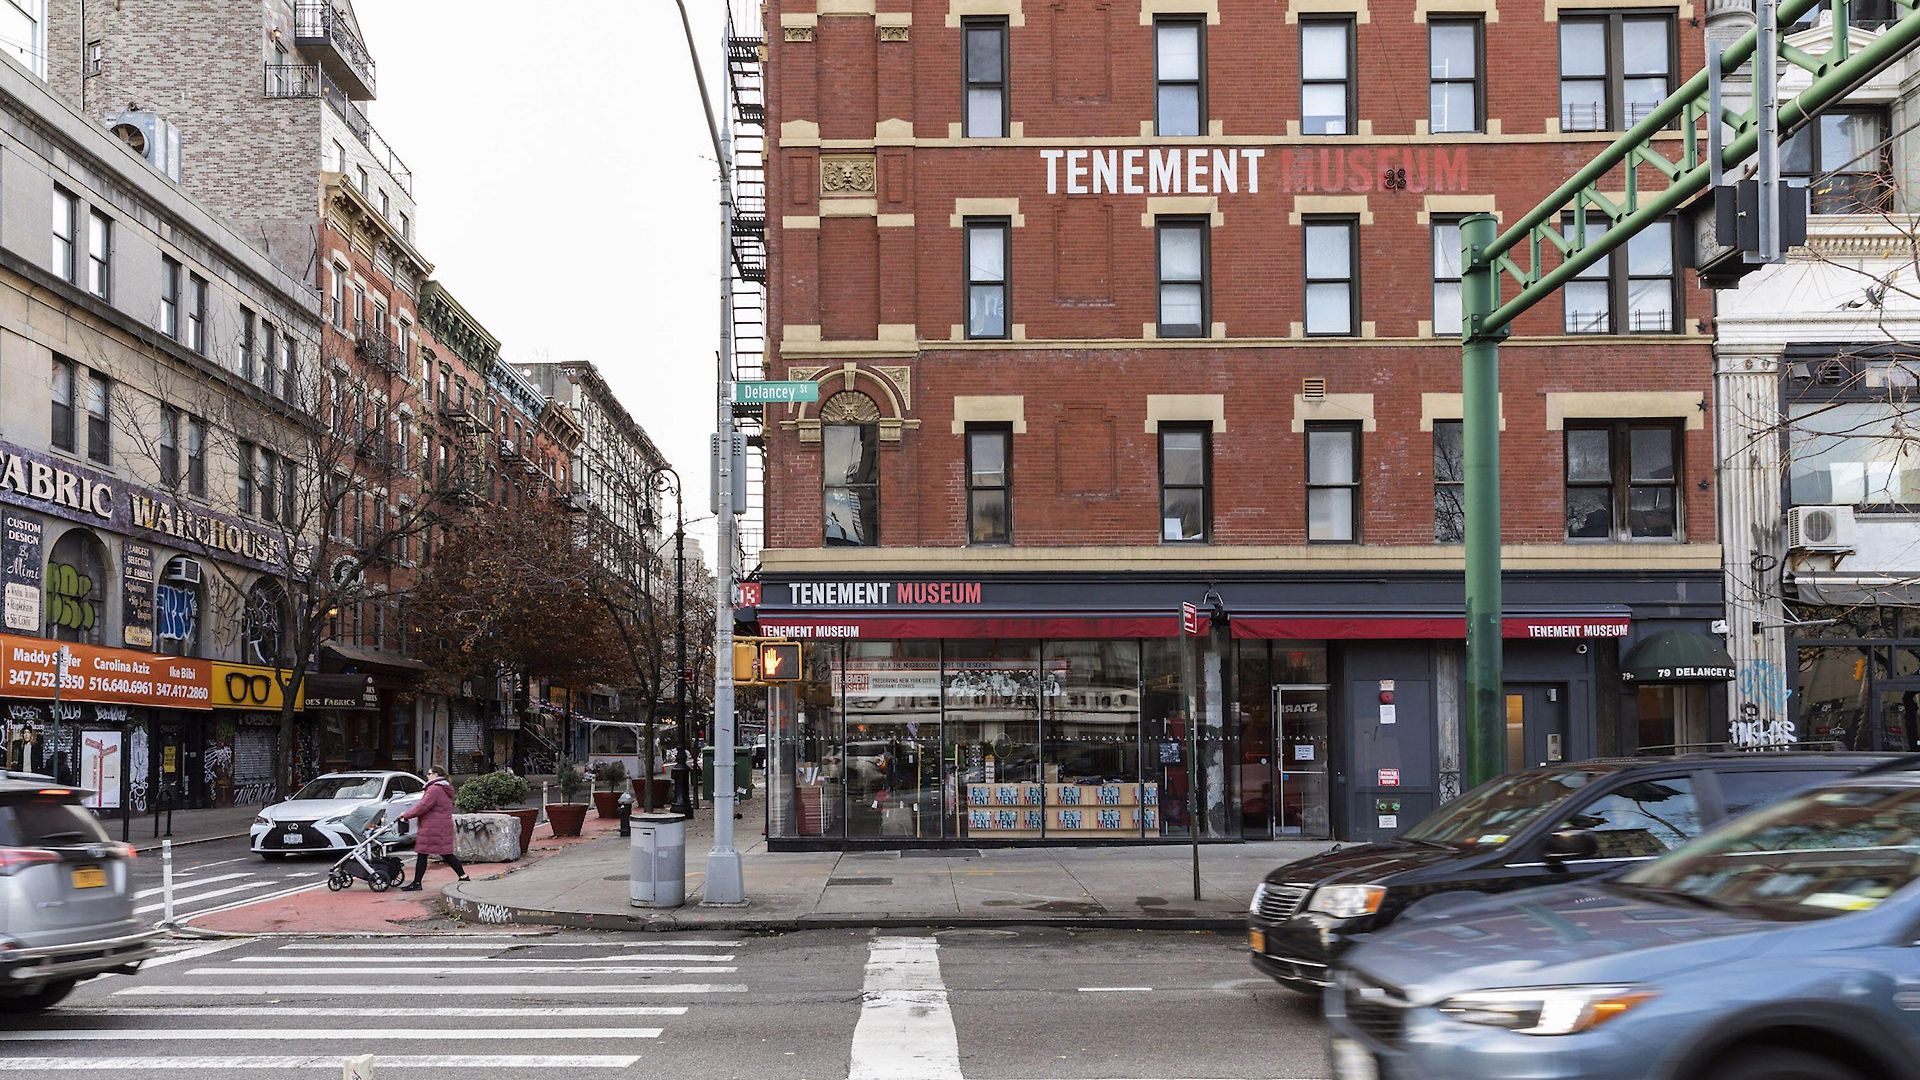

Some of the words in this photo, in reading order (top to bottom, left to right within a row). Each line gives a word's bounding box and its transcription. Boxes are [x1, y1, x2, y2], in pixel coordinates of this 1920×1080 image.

[1040, 149, 1265, 195] TENEMENT
[1282, 147, 1468, 194] MUSEUM
[745, 384, 795, 401] Delancey
[800, 384, 808, 393] St
[0, 451, 113, 519] ABRIC
[7, 517, 41, 533] CUSTOM
[8, 530, 39, 545] DESIGN
[129, 545, 149, 556] LARGEST
[7, 558, 39, 579] Mimi
[127, 556, 151, 567] SELECTION
[126, 567, 132, 575] OF
[134, 568, 153, 580] FABRICS
[789, 583, 890, 604] TENEMENT
[897, 583, 981, 604] MUSEUM
[761, 626, 813, 637] TENEMENT
[816, 626, 859, 637] MUSEUM
[1528, 625, 1581, 637] TENEMENT
[1584, 624, 1628, 637] MUSEUM
[13, 648, 51, 667] Maddy
[94, 657, 131, 673] Carolina
[132, 662, 150, 674] Aziz
[169, 666, 181, 678] Ike
[181, 668, 196, 680] Bibi
[1657, 669, 1671, 678] 79
[1675, 667, 1727, 677] DELANCEY
[9, 669, 84, 690] 347.7525350
[89, 677, 153, 694] 516.640.6961
[156, 682, 208, 700] 347.417.2860
[462, 681, 472, 697] 98
[324, 698, 356, 706] FABRICS
